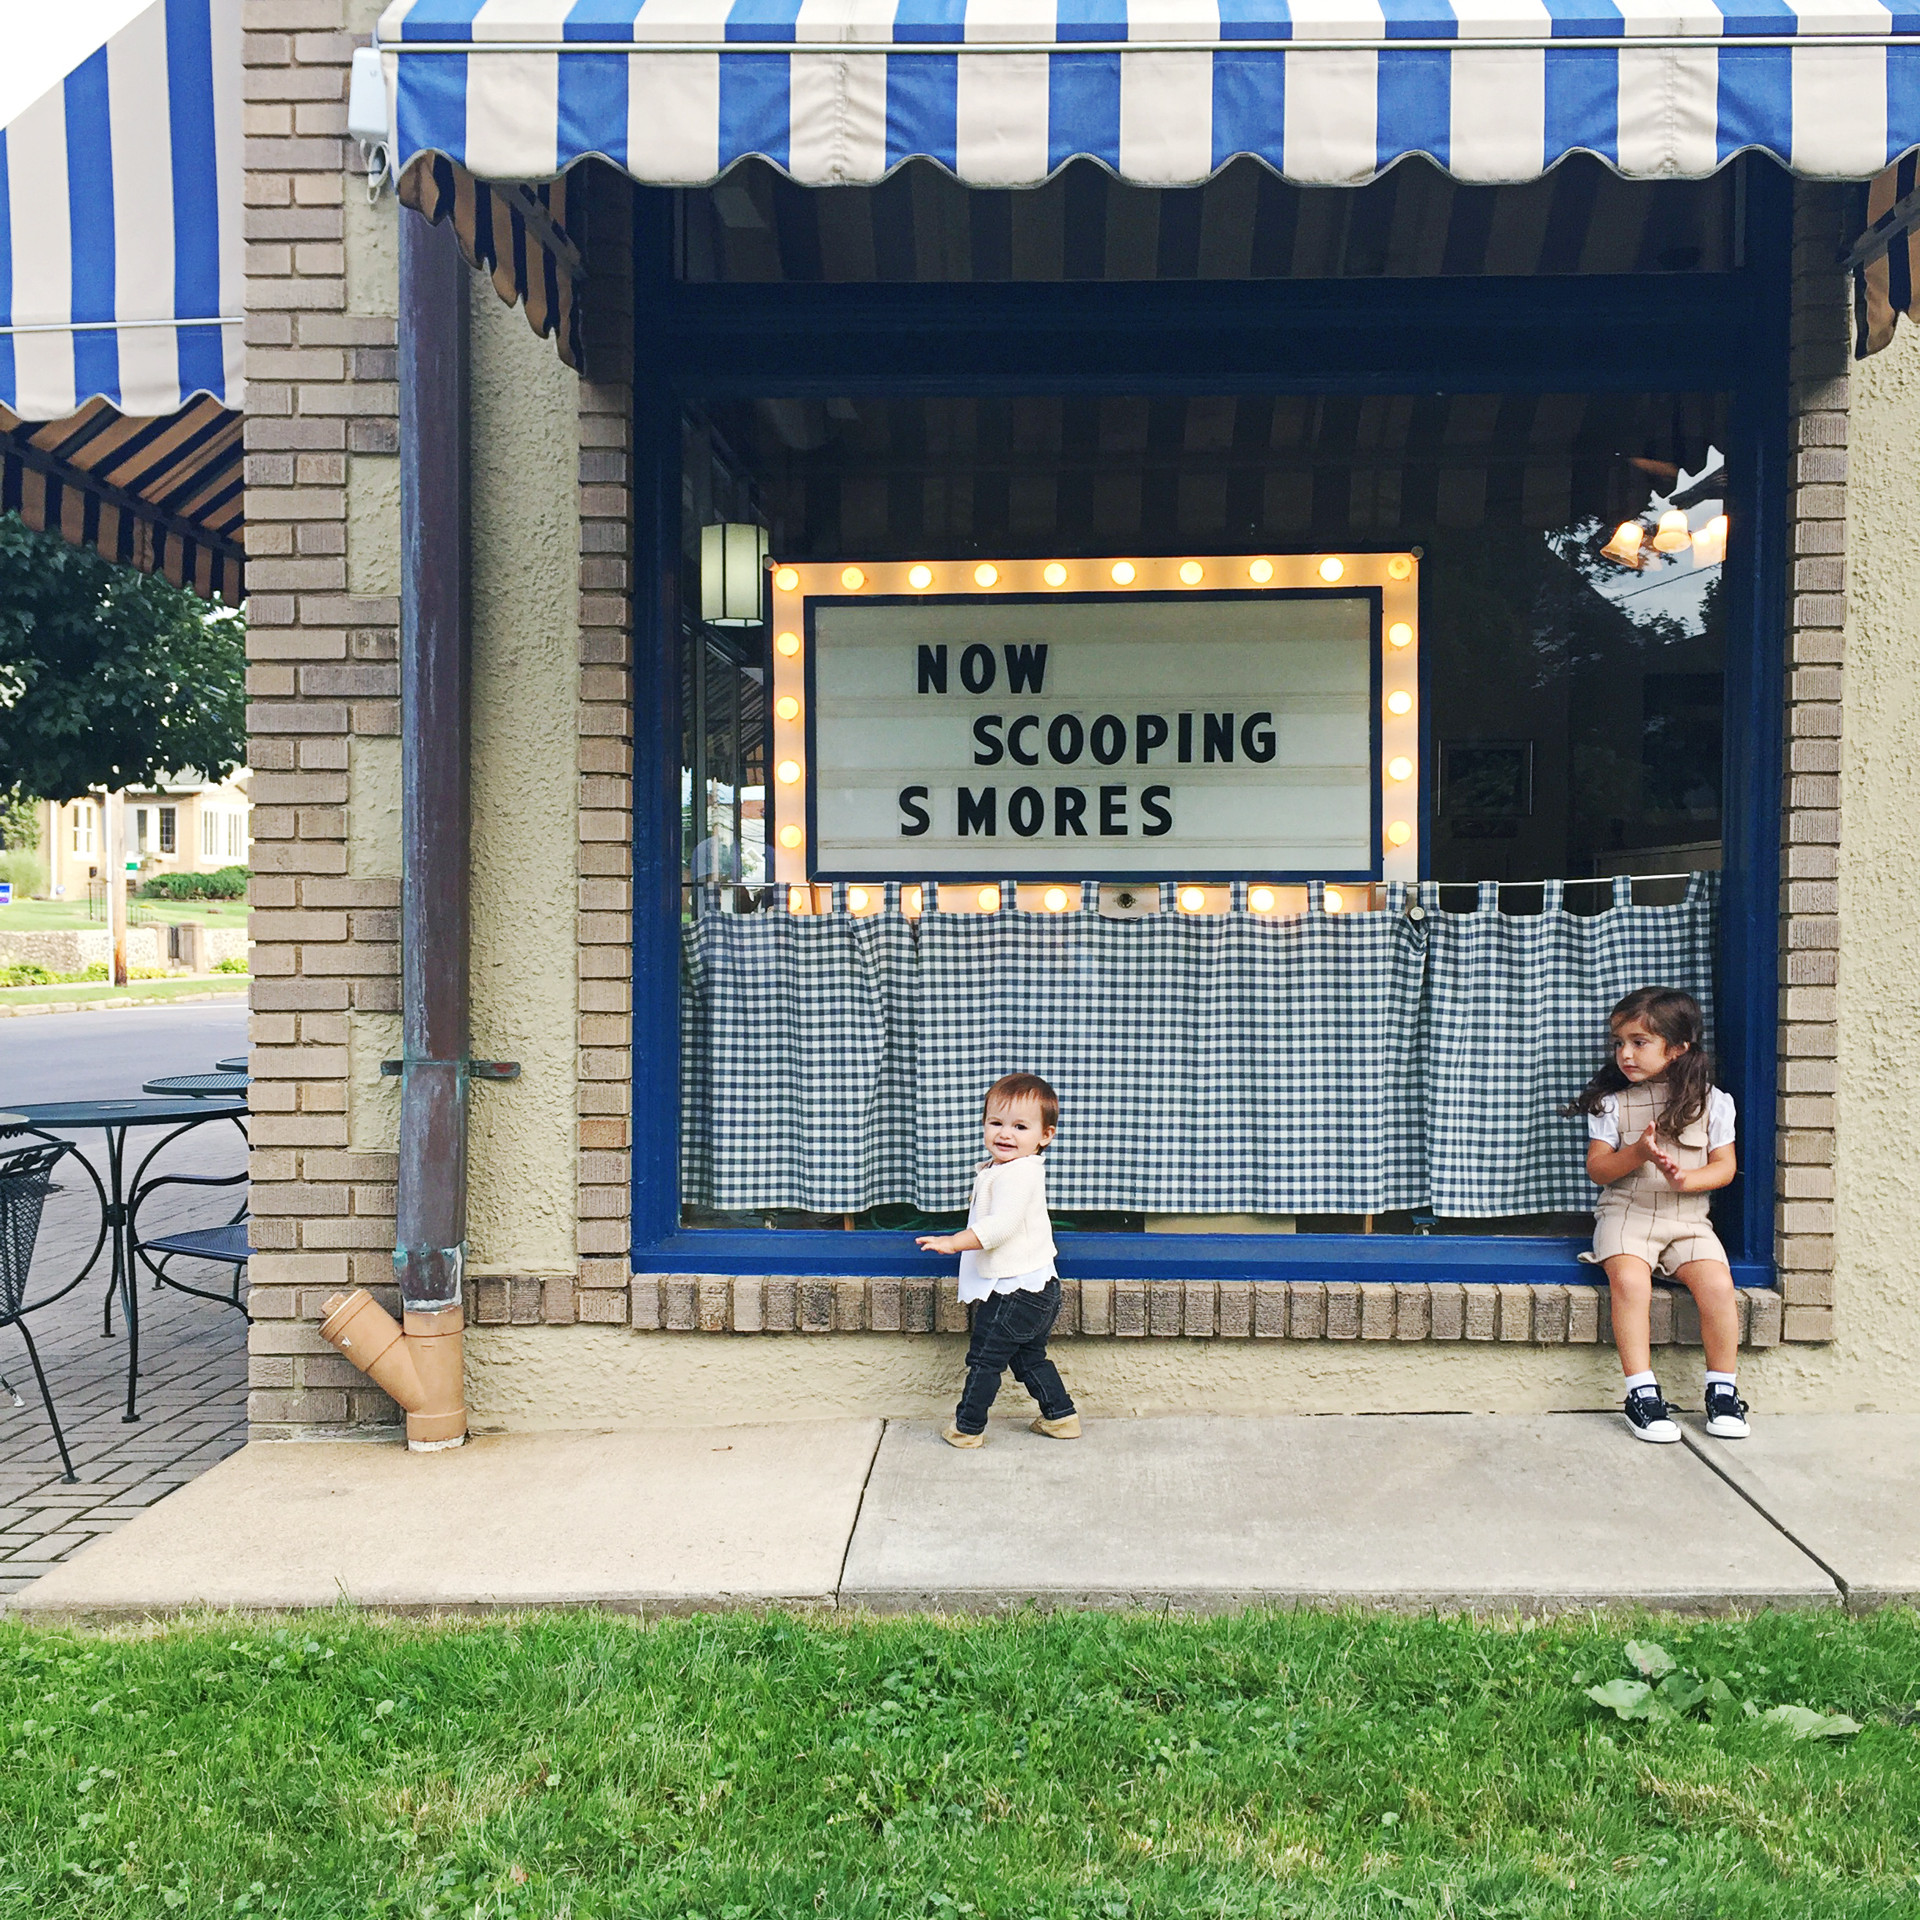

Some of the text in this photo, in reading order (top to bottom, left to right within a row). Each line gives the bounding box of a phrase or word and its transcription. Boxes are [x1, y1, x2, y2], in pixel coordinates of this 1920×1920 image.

[917, 643, 1049, 694] NOW
[972, 712, 1277, 765] SCOOPING
[898, 785, 1173, 837] S MORES
